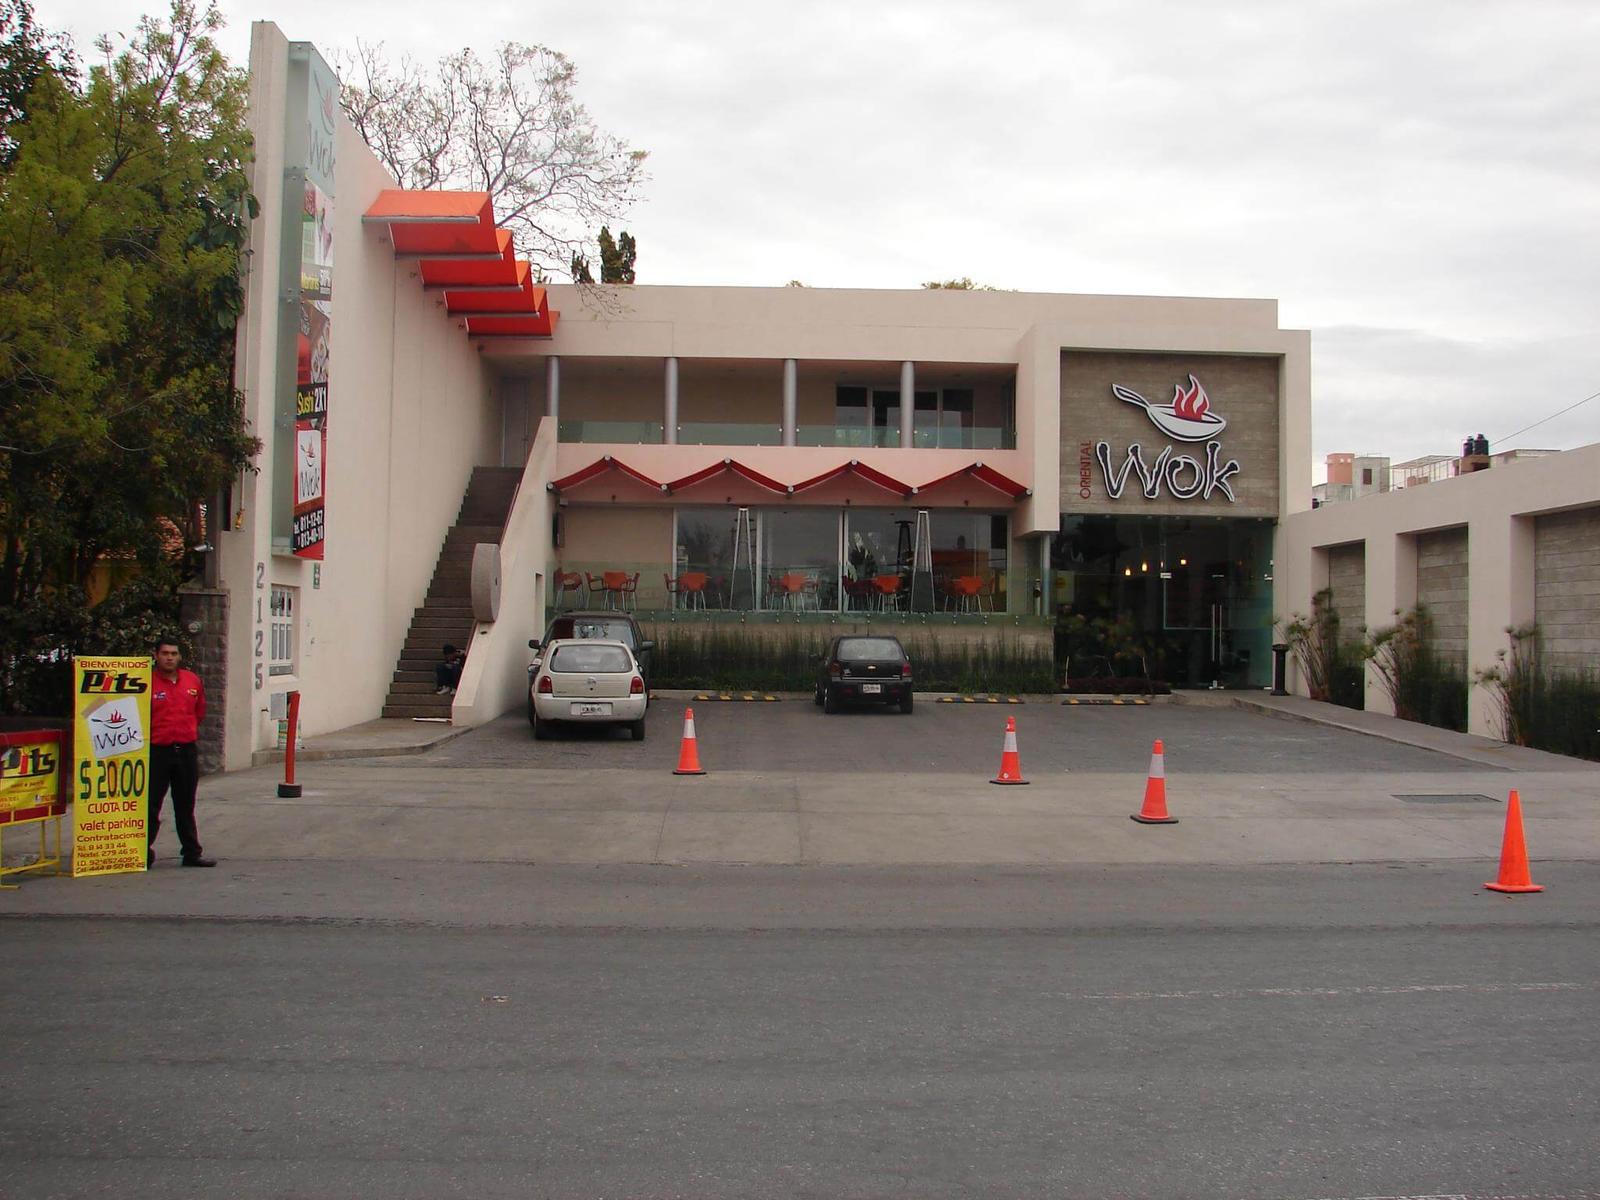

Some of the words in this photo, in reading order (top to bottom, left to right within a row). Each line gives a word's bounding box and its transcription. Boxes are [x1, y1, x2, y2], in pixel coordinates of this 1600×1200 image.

[297, 391, 314, 415] Sushi
[1080, 440, 1092, 499] ORIENTAL
[1096, 441, 1240, 502] Wok
[80, 660, 149, 669] BIENVENIDOS
[80, 669, 148, 694] Pits
[87, 802, 121, 814] CUOTA
[122, 801, 138, 812] DE
[80, 820, 106, 831] valet
[107, 818, 145, 832] parking
[76, 832, 147, 843] Contrataciones
